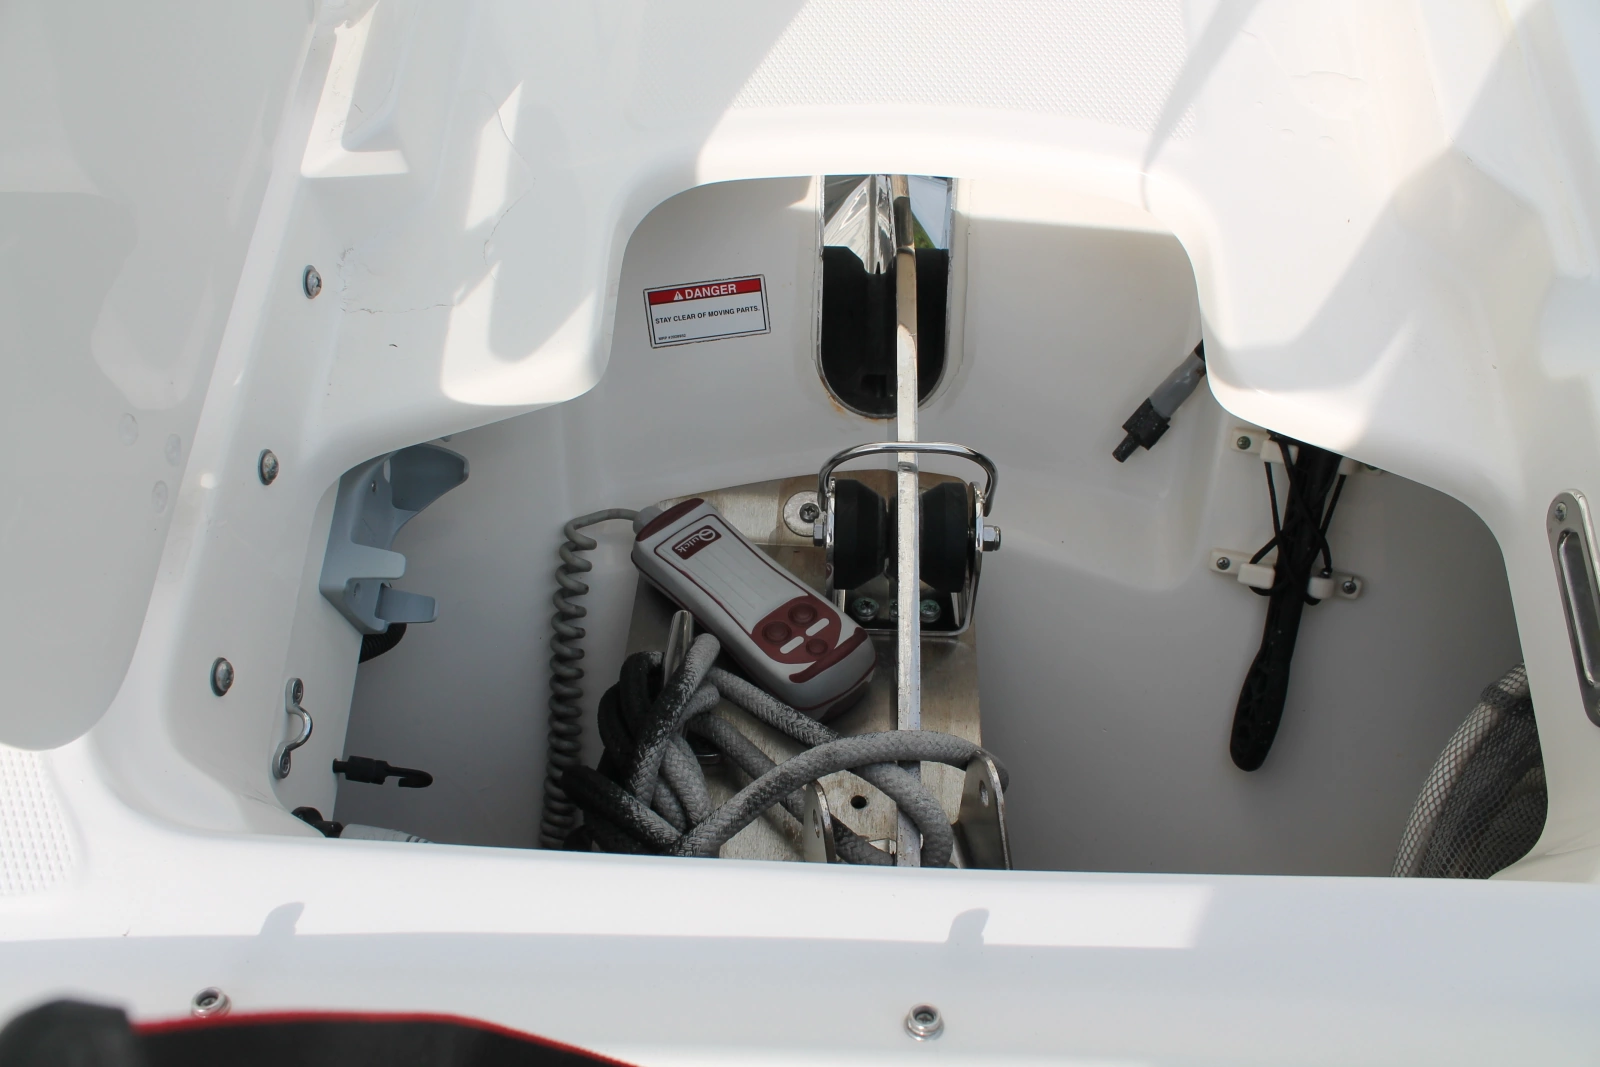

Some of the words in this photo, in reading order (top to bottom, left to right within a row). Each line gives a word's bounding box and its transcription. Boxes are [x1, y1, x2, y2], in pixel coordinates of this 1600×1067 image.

[685, 284, 737, 300] DANGER
[655, 316, 672, 325] STAY
[673, 313, 696, 322] CLEAR
[708, 308, 735, 317] MOVING
[736, 305, 760, 314] PARTS.
[674, 528, 716, 553] Quick
